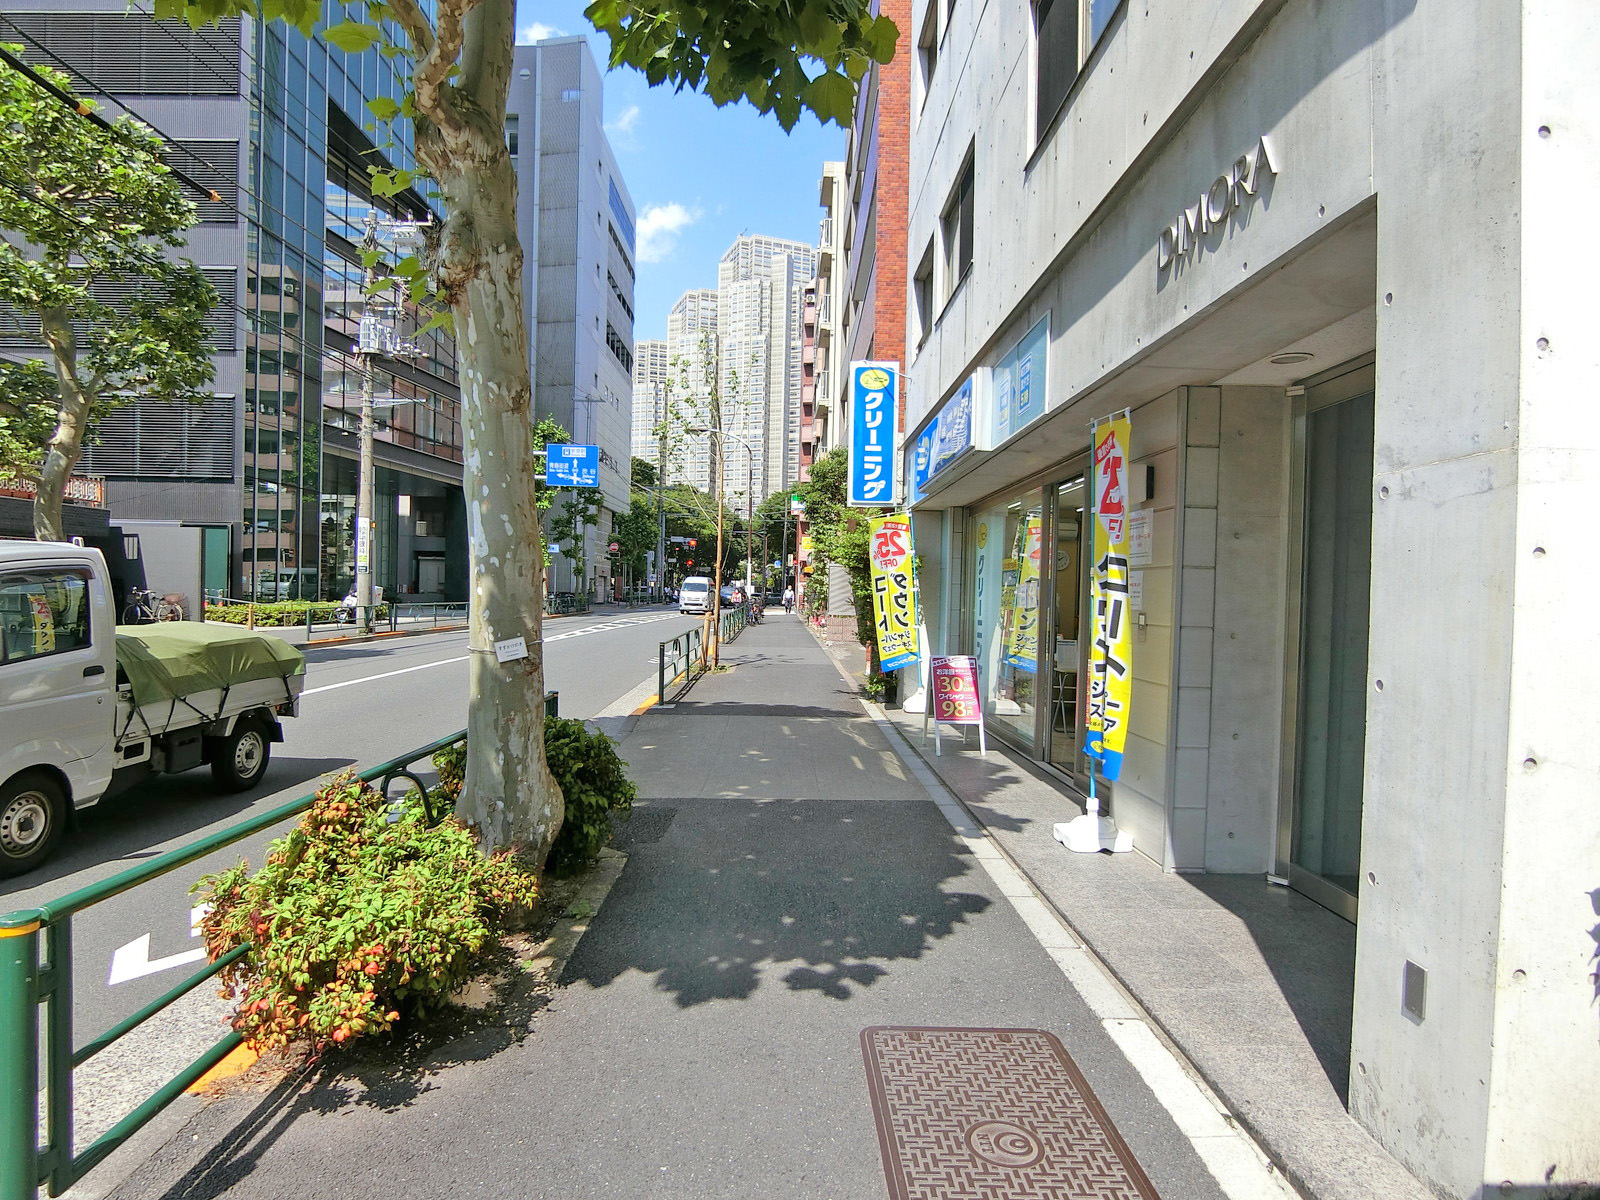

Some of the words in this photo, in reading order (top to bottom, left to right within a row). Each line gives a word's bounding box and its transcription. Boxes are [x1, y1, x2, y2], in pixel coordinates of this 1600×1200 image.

[1158, 135, 1279, 272] DIMORA
[864, 392, 886, 499] クリーニング
[976, 1133, 995, 1153] NTT
